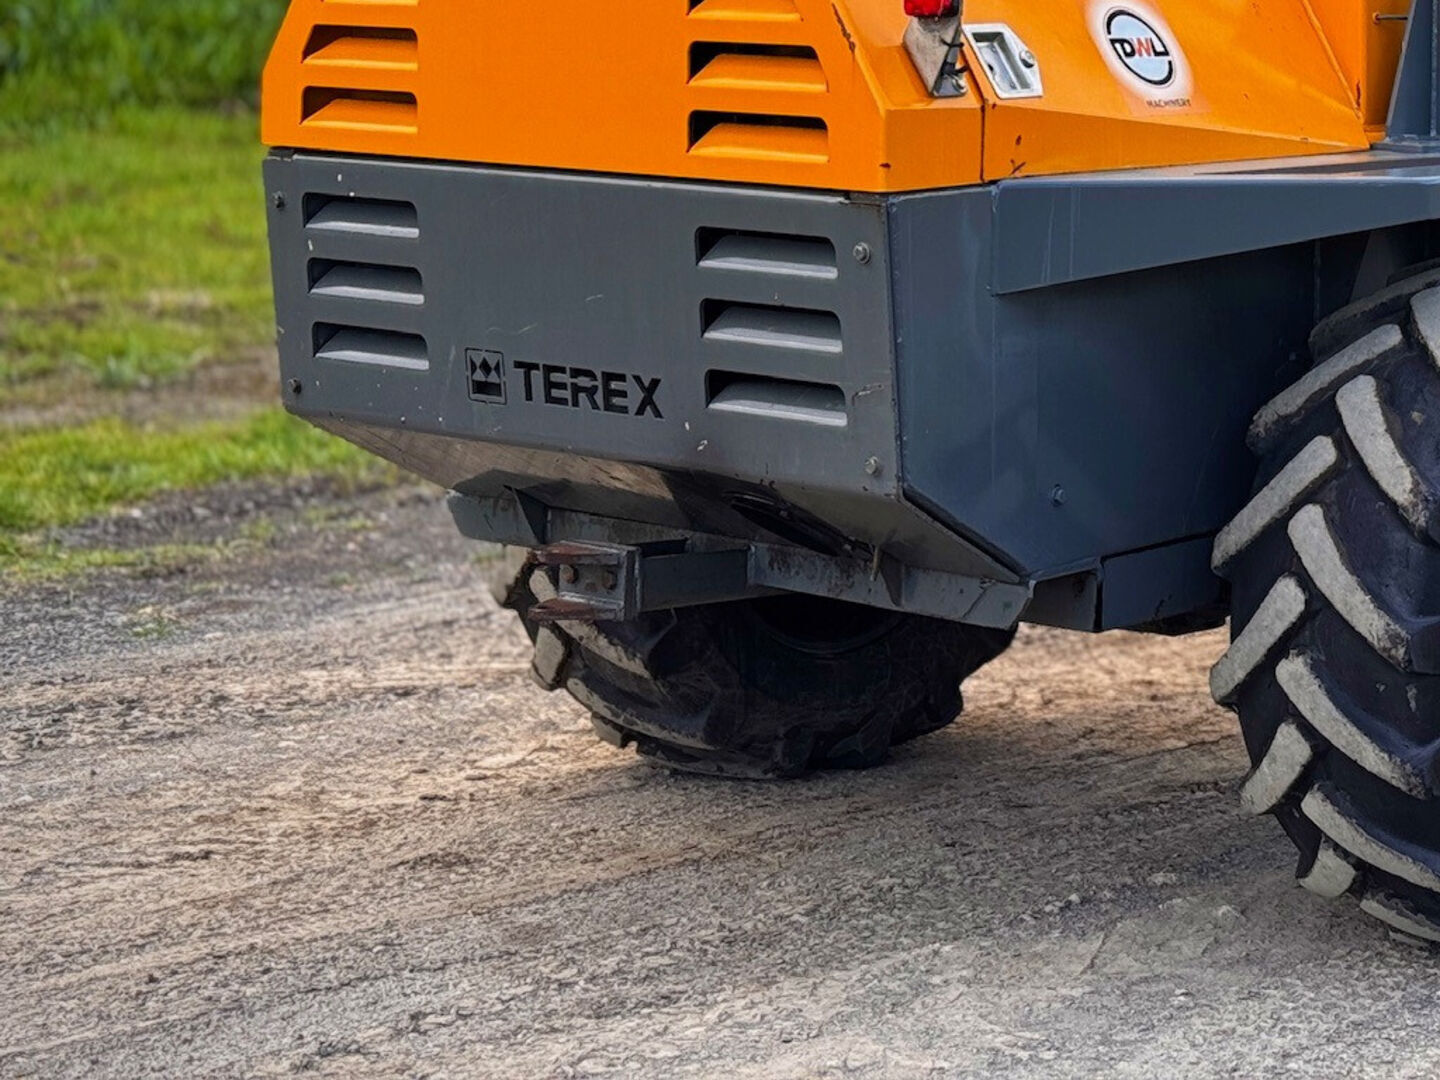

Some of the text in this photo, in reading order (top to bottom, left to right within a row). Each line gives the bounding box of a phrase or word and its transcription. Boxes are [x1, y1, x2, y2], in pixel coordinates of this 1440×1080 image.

[1109, 38, 1171, 58] DWL
[1146, 99, 1192, 108] MACHINERY
[513, 360, 664, 419] TEREX
